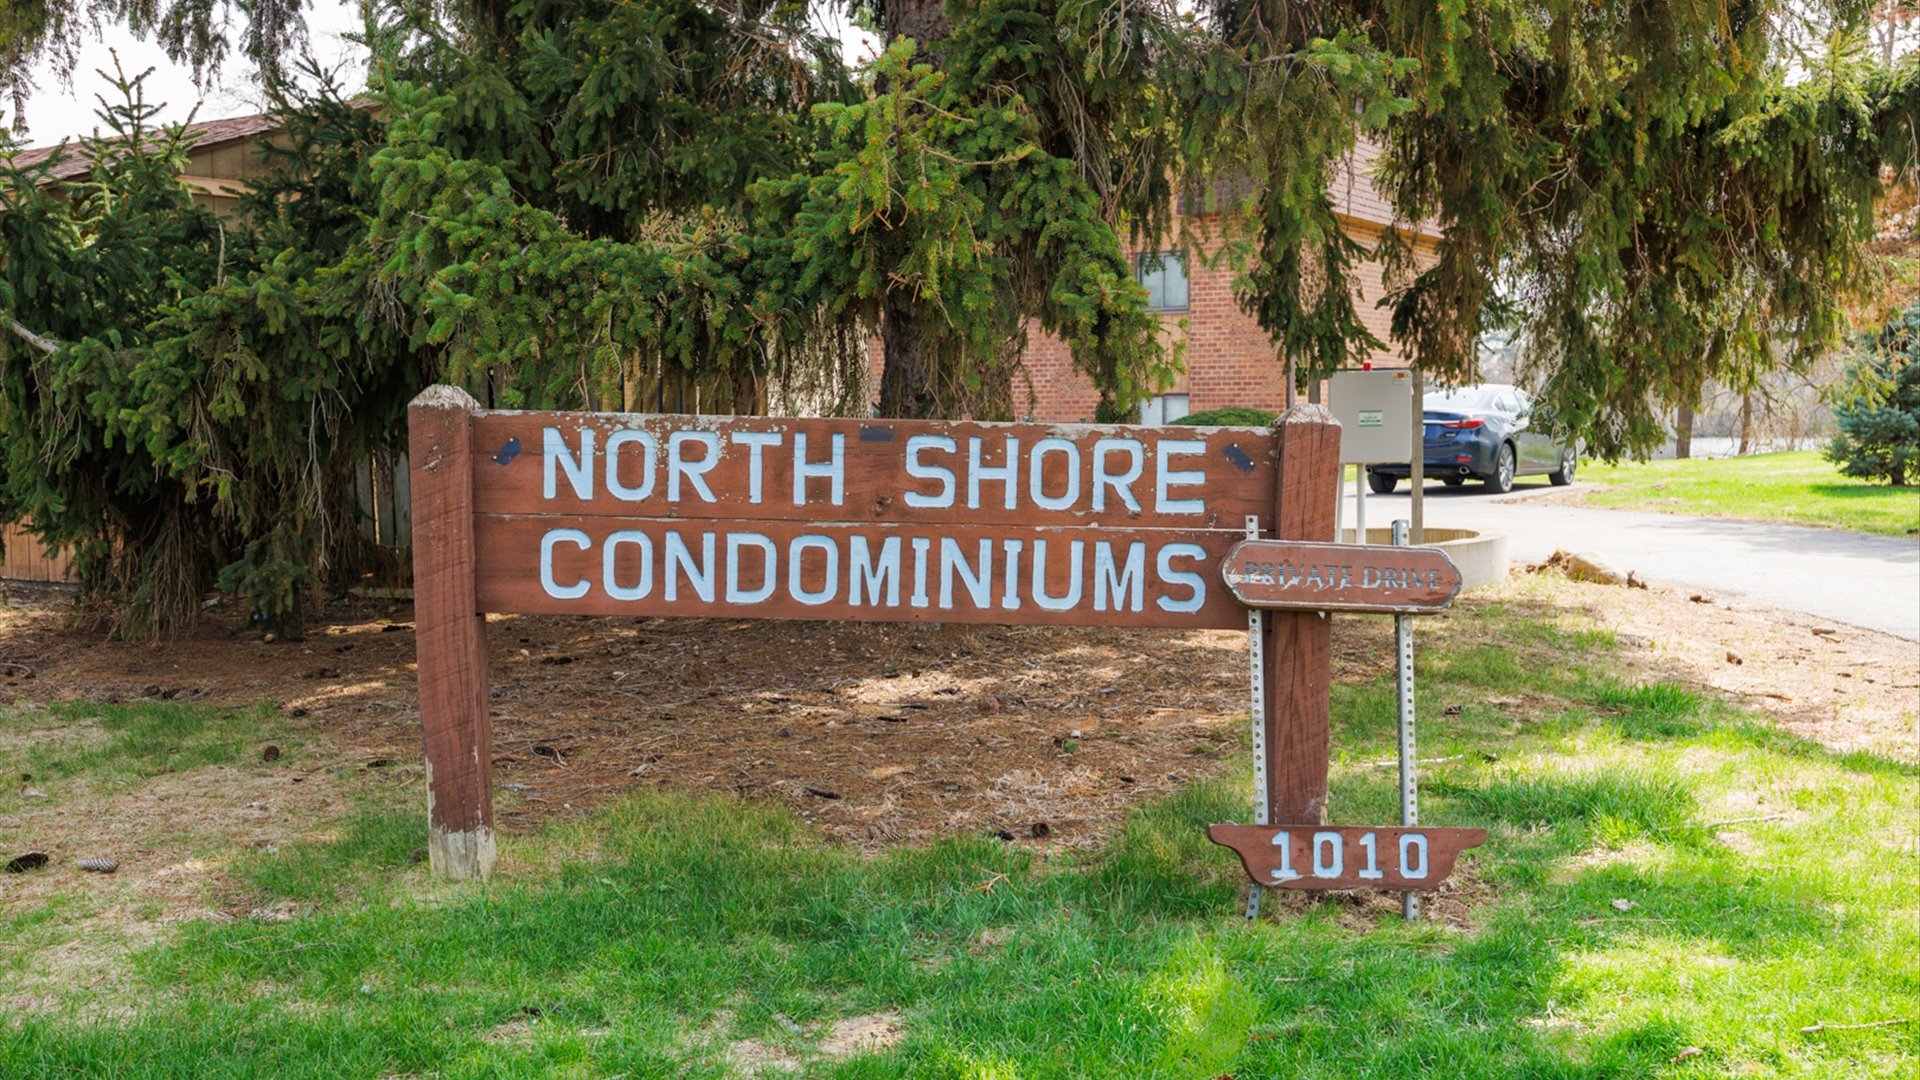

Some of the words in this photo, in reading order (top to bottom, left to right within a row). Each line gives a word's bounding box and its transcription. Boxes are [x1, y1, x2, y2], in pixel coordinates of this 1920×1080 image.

[543, 427, 845, 506] NORTH
[904, 435, 1207, 513] SHORE
[540, 528, 1207, 613] CONDOMINIUMS
[1245, 561, 1354, 588] PRIVATE
[1363, 567, 1442, 589] DRIVE
[1271, 831, 1428, 879] 1010
